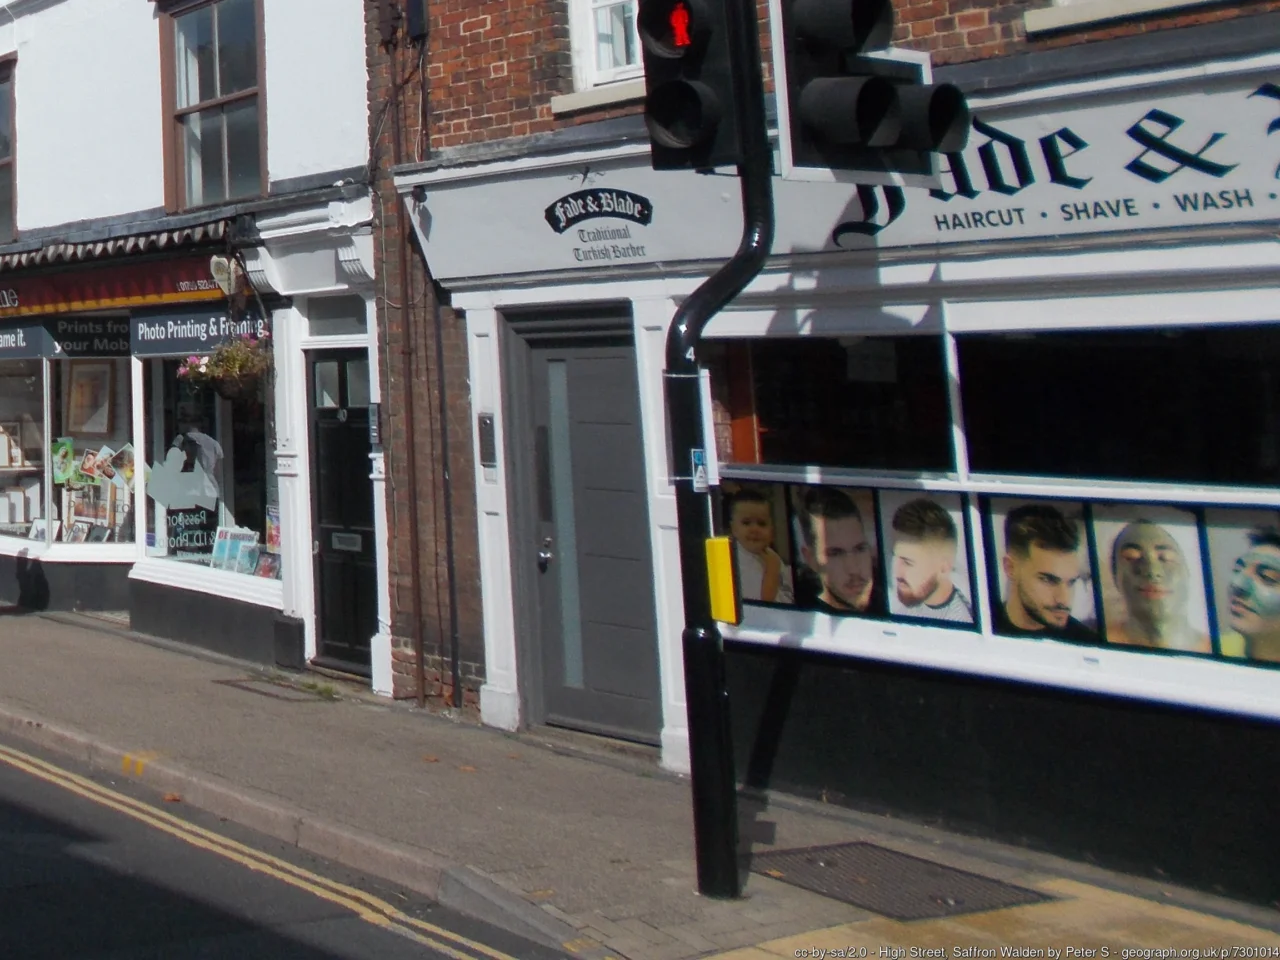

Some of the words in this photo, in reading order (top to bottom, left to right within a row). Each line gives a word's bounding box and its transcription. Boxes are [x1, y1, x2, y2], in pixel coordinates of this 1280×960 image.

[1124, 109, 1240, 183] &
[555, 196, 586, 229] Fade
[587, 195, 599, 213] &
[599, 192, 642, 218] Blade
[934, 208, 1025, 231] HAIRCUT
[1060, 197, 1139, 221] SHAVE
[1174, 189, 1254, 212] WASH
[573, 244, 611, 261] Turkish
[612, 243, 646, 259] Barber
[57, 321, 103, 334] Prints
[107, 320, 129, 334] fro
[138, 322, 166, 340] Photo
[168, 319, 207, 341] Printing
[209, 317, 218, 336] &
[220, 315, 264, 338] Framing
[17, 328, 26, 347] it.
[54, 341, 88, 354] your
[94, 338, 129, 351] Mob
[686, 346, 695, 362] 4
